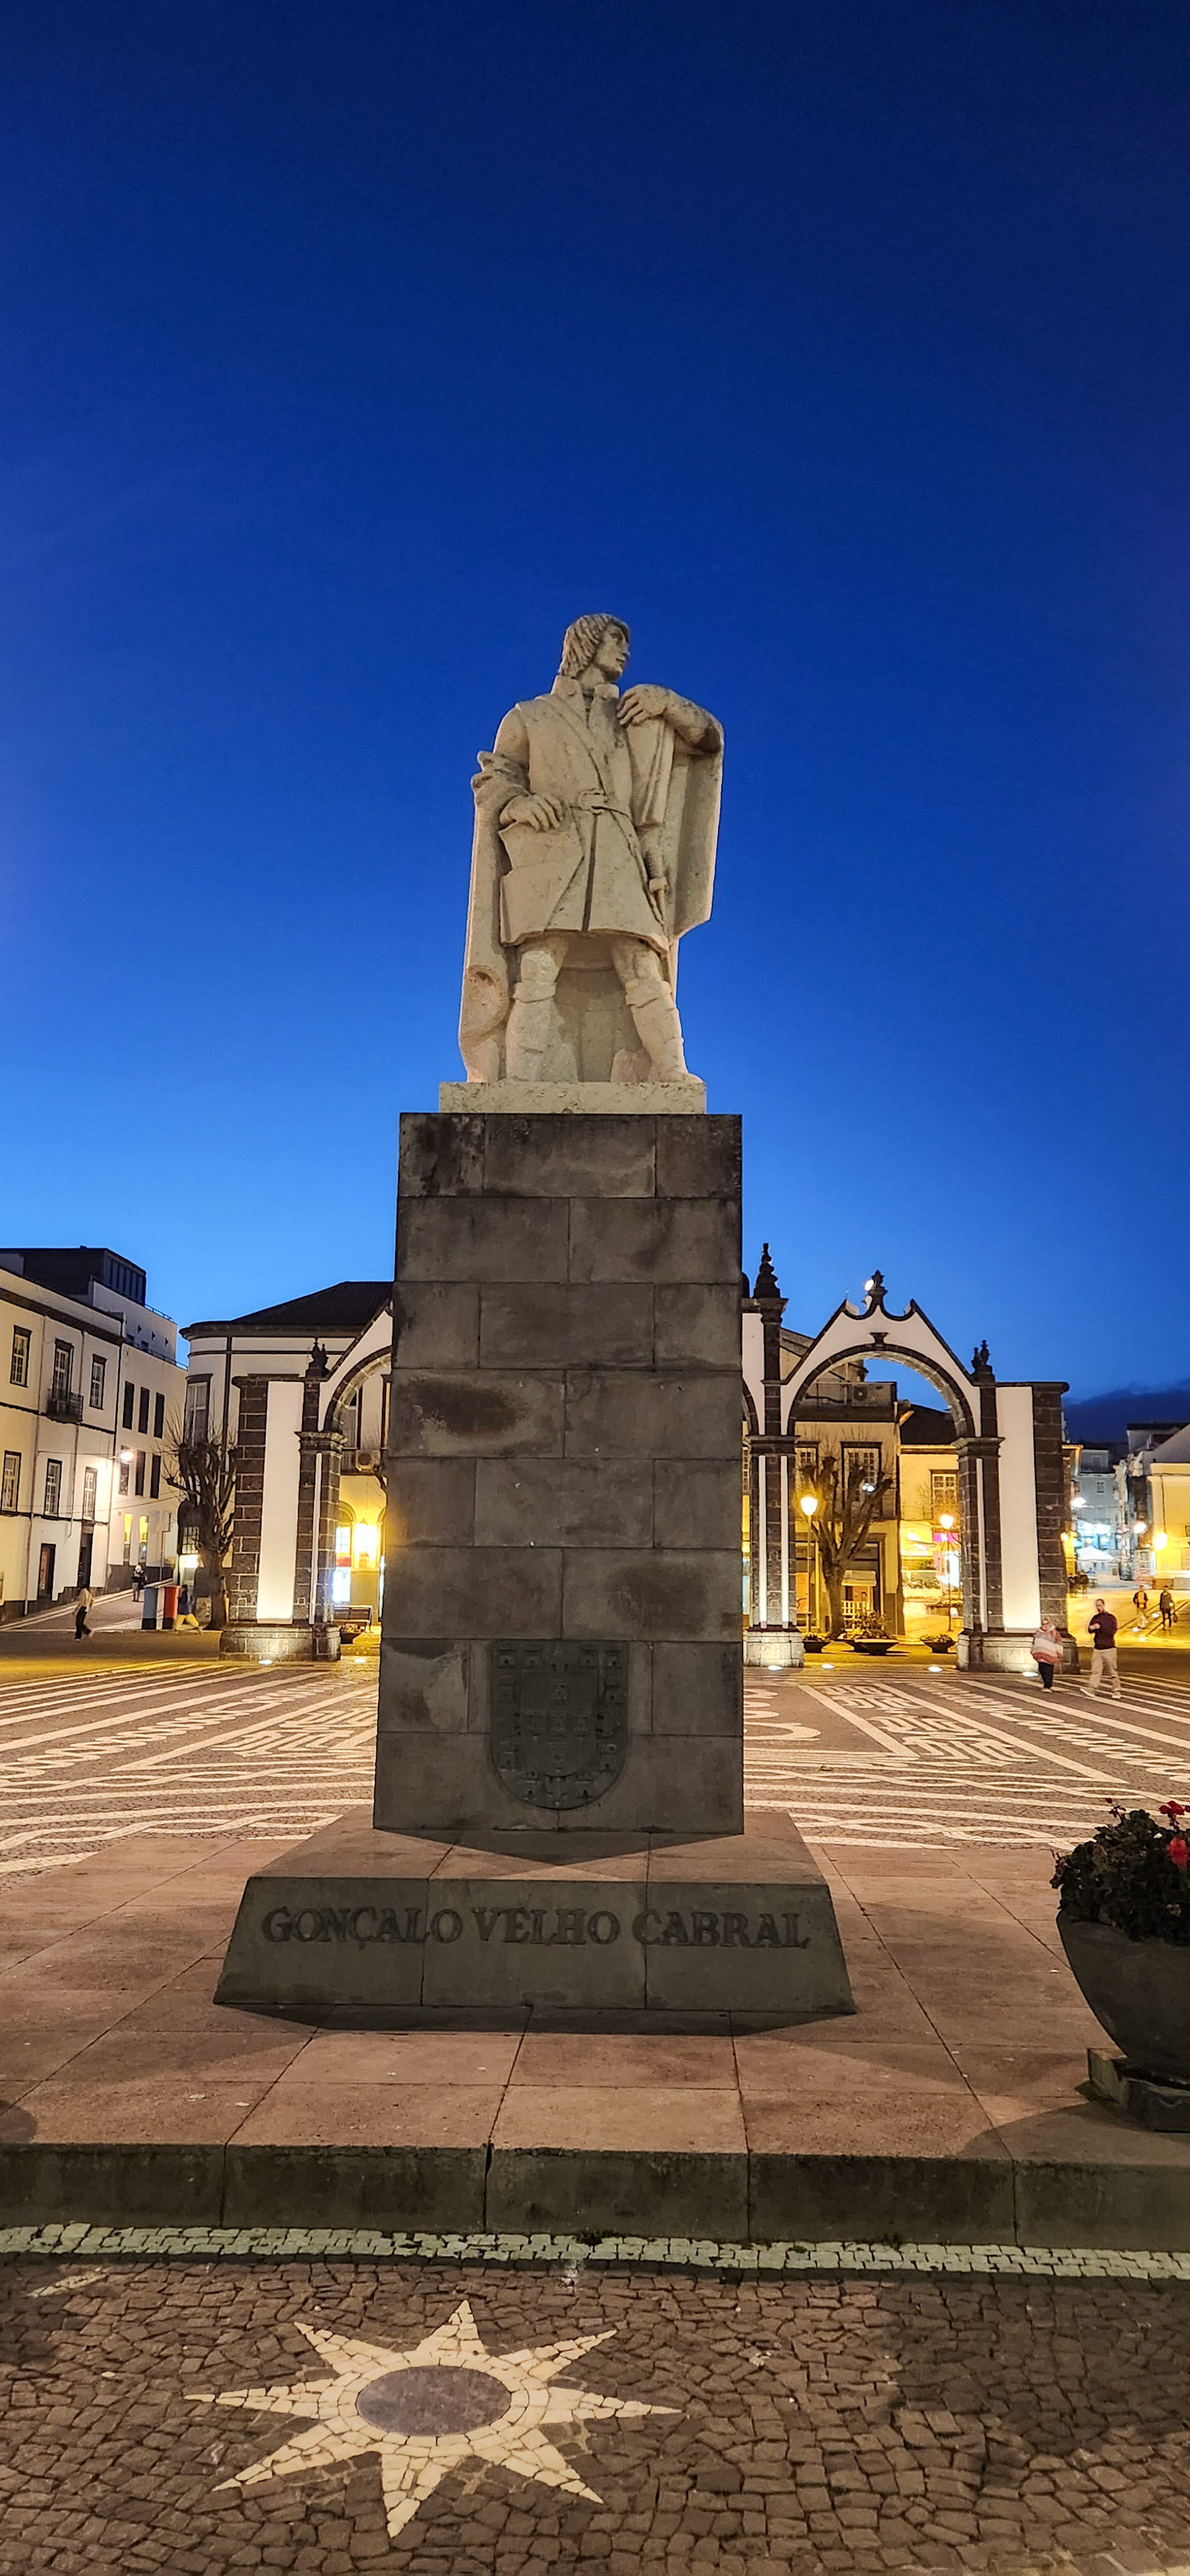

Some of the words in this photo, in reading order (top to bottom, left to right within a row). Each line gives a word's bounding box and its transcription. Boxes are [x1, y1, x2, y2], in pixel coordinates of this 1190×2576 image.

[261, 1906, 463, 1950] GONÇALO
[471, 1907, 621, 1946] VELHO
[632, 1909, 811, 1949] CABRAL
